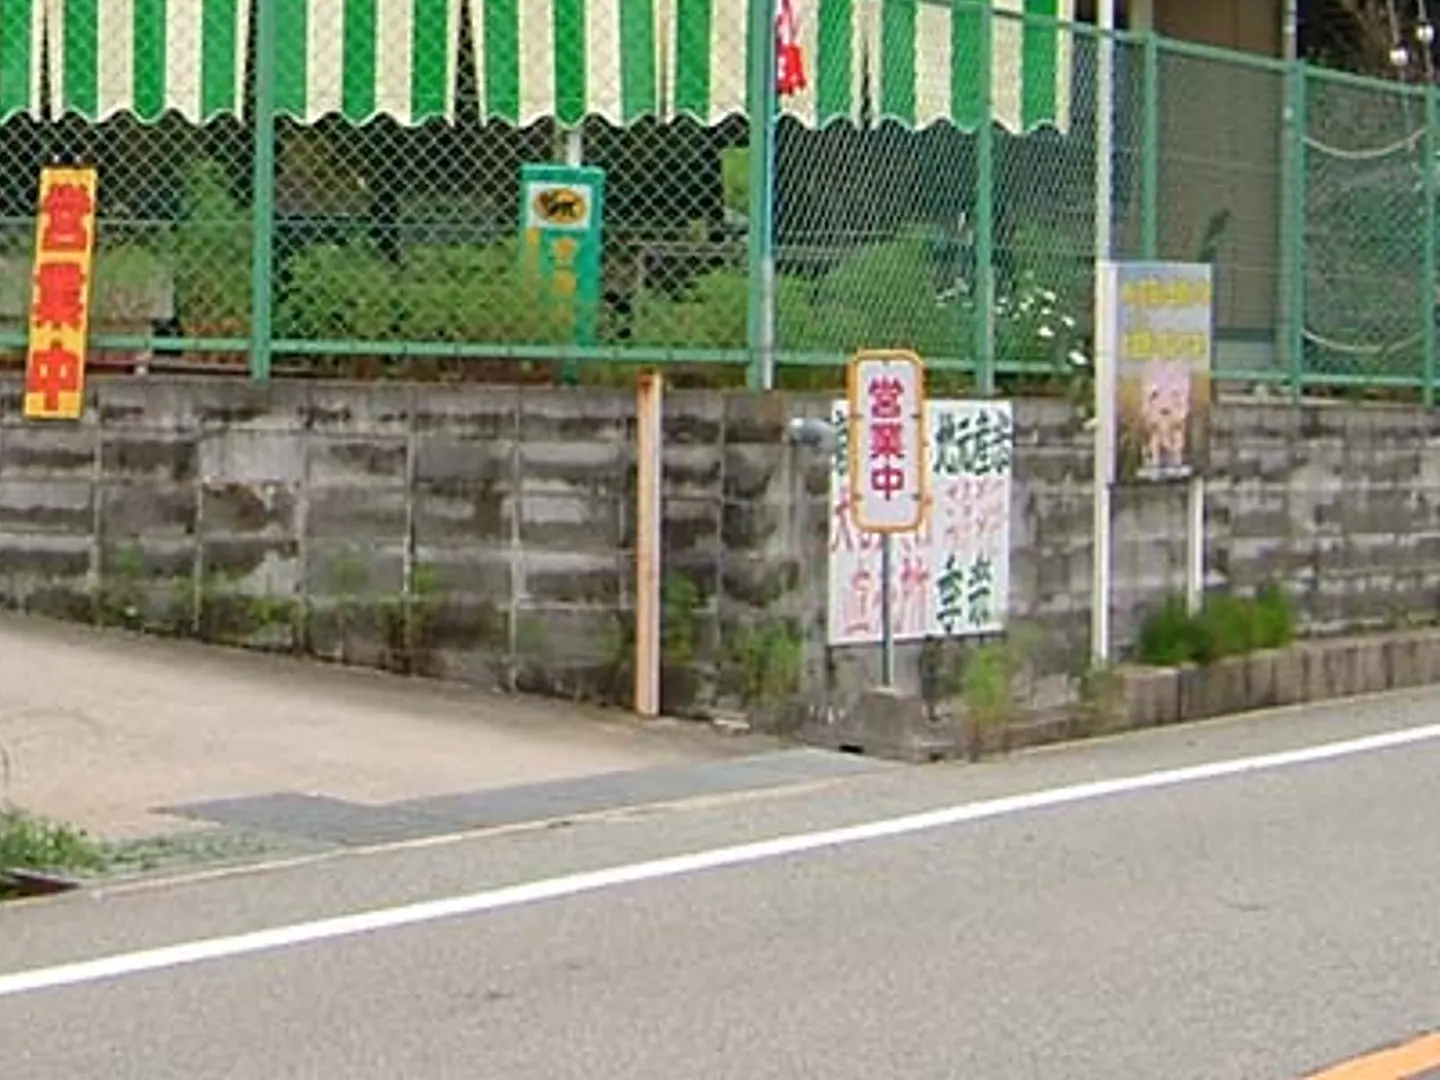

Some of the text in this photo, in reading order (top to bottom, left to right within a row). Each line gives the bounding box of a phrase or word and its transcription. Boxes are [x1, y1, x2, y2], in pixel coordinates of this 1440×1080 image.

[27, 183, 91, 410] 営業中
[868, 375, 906, 501] 営業中
